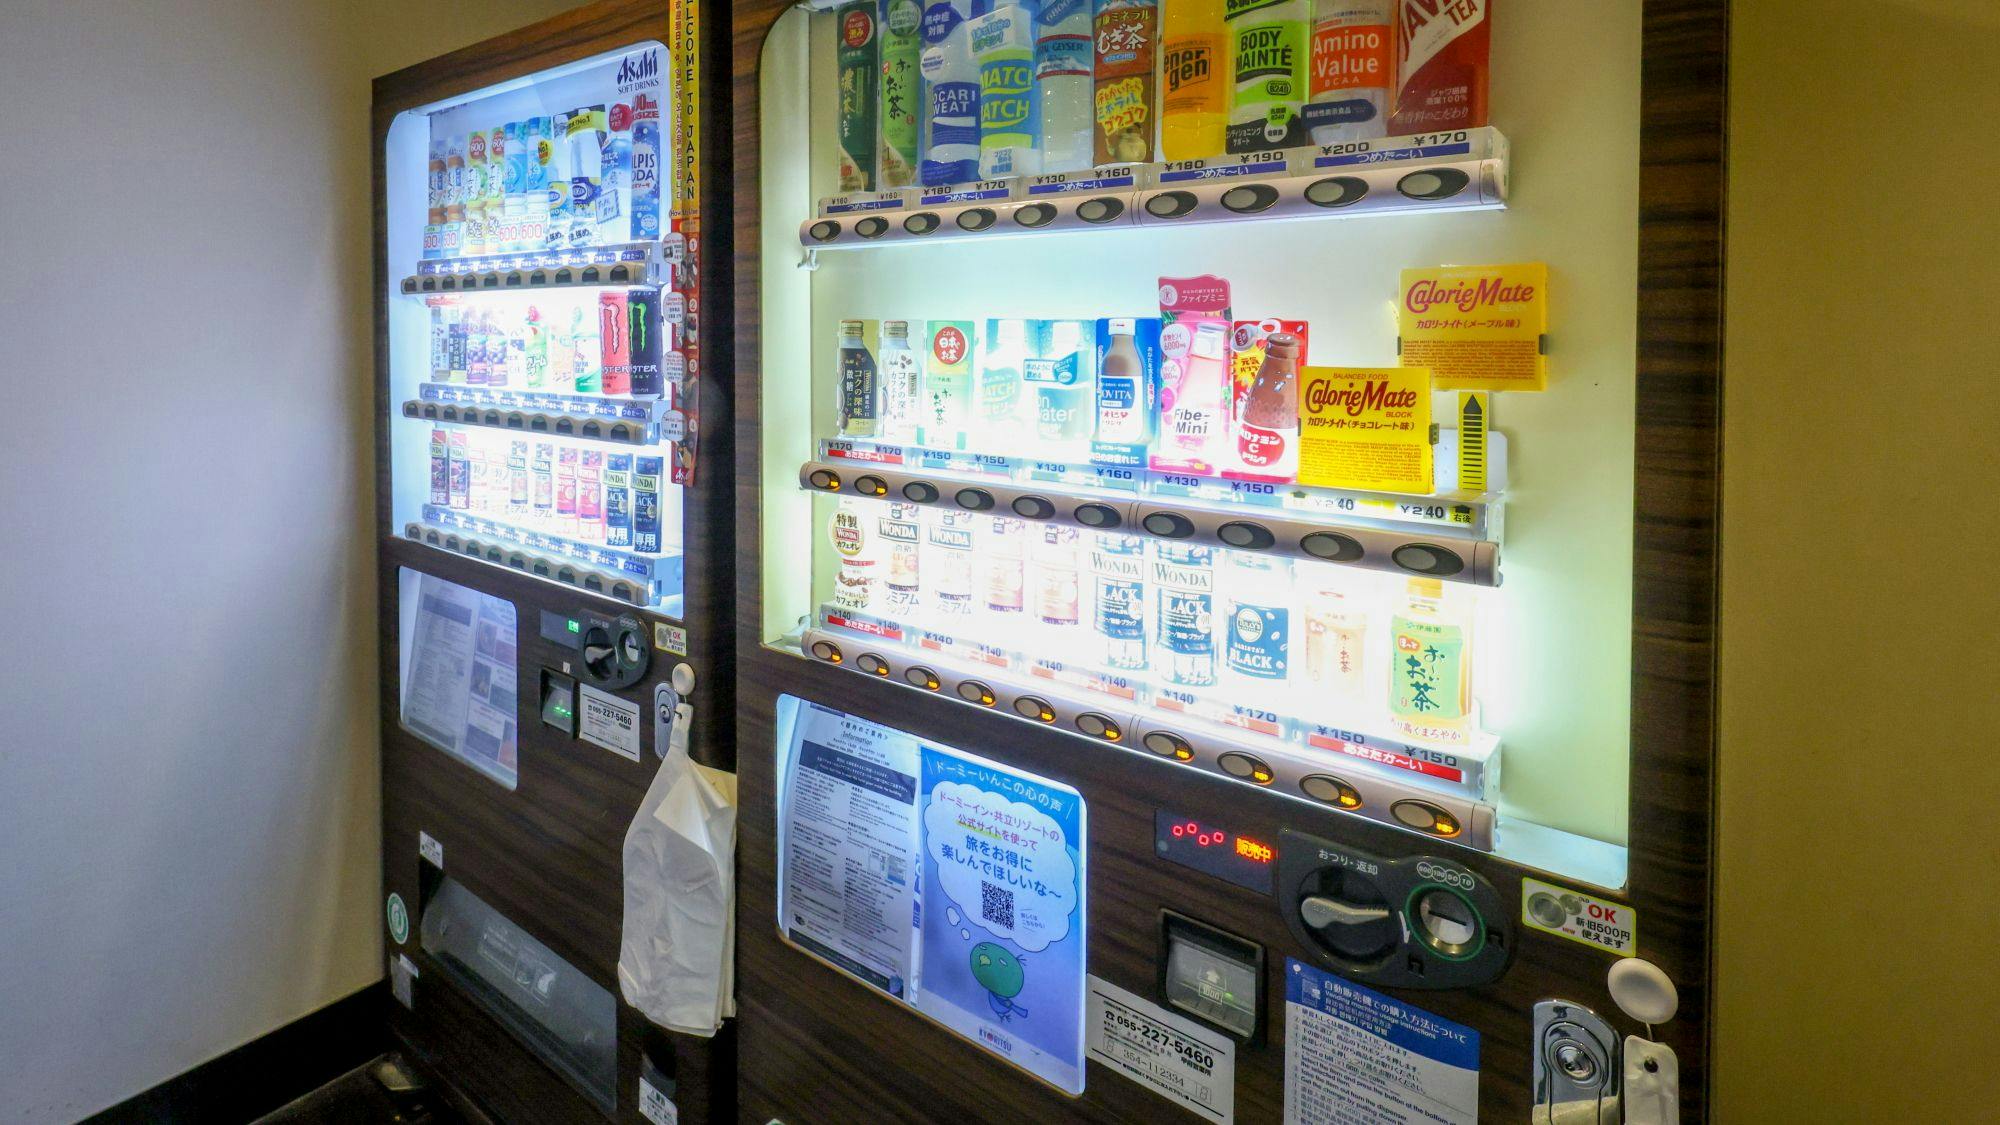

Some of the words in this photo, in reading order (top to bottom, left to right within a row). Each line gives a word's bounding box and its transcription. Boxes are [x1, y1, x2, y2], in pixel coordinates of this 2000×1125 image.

[1444, 0, 1478, 26] TEA
[1052, 43, 1083, 52] GEYSER
[1097, 23, 1148, 54] むぎ茶
[1241, 30, 1280, 51] BODY
[1313, 31, 1380, 56] Amino
[617, 48, 659, 84] Asahi
[1164, 48, 1206, 76] ener
[1236, 44, 1292, 71] MAINTÉ
[1316, 53, 1379, 77] Value
[617, 82, 634, 94] SOFT
[634, 78, 660, 92] DRINKS
[1169, 58, 1208, 92] gen
[1324, 77, 1361, 88] BCAA
[686, 92, 694, 116] TO
[886, 76, 907, 121] お茶
[1321, 142, 1370, 156] ¥200
[1413, 131, 1467, 146] ¥170
[685, 125, 695, 199] JAPAN
[1165, 160, 1204, 172] ¥180
[1240, 151, 1284, 164] ¥190
[976, 180, 1006, 191] ¥170
[1036, 174, 1066, 185] ¥130
[1095, 167, 1131, 179] ¥160
[521, 223, 543, 238] 600
[1181, 293, 1226, 303] ファイブミニ
[1174, 408, 1211, 421] Fibe-
[1175, 421, 1208, 435] Mini
[828, 441, 853, 451] ¥170
[875, 444, 901, 456] ¥170
[923, 451, 951, 460] ¥150
[975, 454, 1005, 464] ¥150
[1248, 443, 1259, 454] C
[1036, 462, 1066, 473] ¥130
[1096, 468, 1132, 480] ¥160
[1164, 475, 1199, 487] ¥130
[1231, 481, 1275, 494] ¥150
[836, 513, 858, 529] 特製
[879, 518, 918, 540] WONDA
[1453, 512, 1472, 524] 右後
[1092, 552, 1139, 576] WONDA
[1155, 562, 1208, 588] WONDA
[836, 595, 869, 608] カフェオレ
[1104, 583, 1138, 603] LACK
[1170, 598, 1206, 616] LACK
[924, 632, 953, 645] ¥140
[979, 644, 1002, 656] ¥140
[1230, 648, 1273, 669] BLACK
[1038, 659, 1062, 672] ¥140
[1101, 674, 1127, 688] ¥140
[1406, 655, 1440, 712] お茶
[1163, 688, 1194, 704] ¥140
[1233, 704, 1277, 722] ¥170
[842, 730, 873, 746] Information
[1317, 724, 1365, 745] ¥150
[1404, 745, 1457, 767] ¥150
[936, 760, 1063, 812] ドーミーいんこの心の声
[940, 791, 1060, 843] ドーミーイン・共立リゾートの
[958, 813, 1038, 851] 公式サイトを使って
[966, 834, 1034, 873] 旅をお得に
[1318, 849, 1379, 876] おつり・返却
[941, 843, 1062, 899] 楽しんでほしいな〜
[1461, 878, 1473, 887] 10
[1587, 904, 1617, 924] OK
[1581, 930, 1625, 949] 使えます
[1325, 990, 1349, 1005] Vending
[1324, 979, 1466, 1045] 自動販売機での購入方法について
[1116, 1014, 1214, 1069] 055-227-5460
[1320, 1063, 1328, 1071] the
[1344, 1074, 1355, 1083] and
[1373, 1087, 1382, 1095] the
[1384, 1092, 1404, 1105] button
[1413, 1104, 1423, 1114] the
[1424, 1110, 1449, 1125] bottom
[1366, 1097, 1375, 1106] the
[1347, 1097, 1354, 1105] by
[1356, 1101, 1376, 1116] pulling
[1378, 1111, 1396, 1123] down
